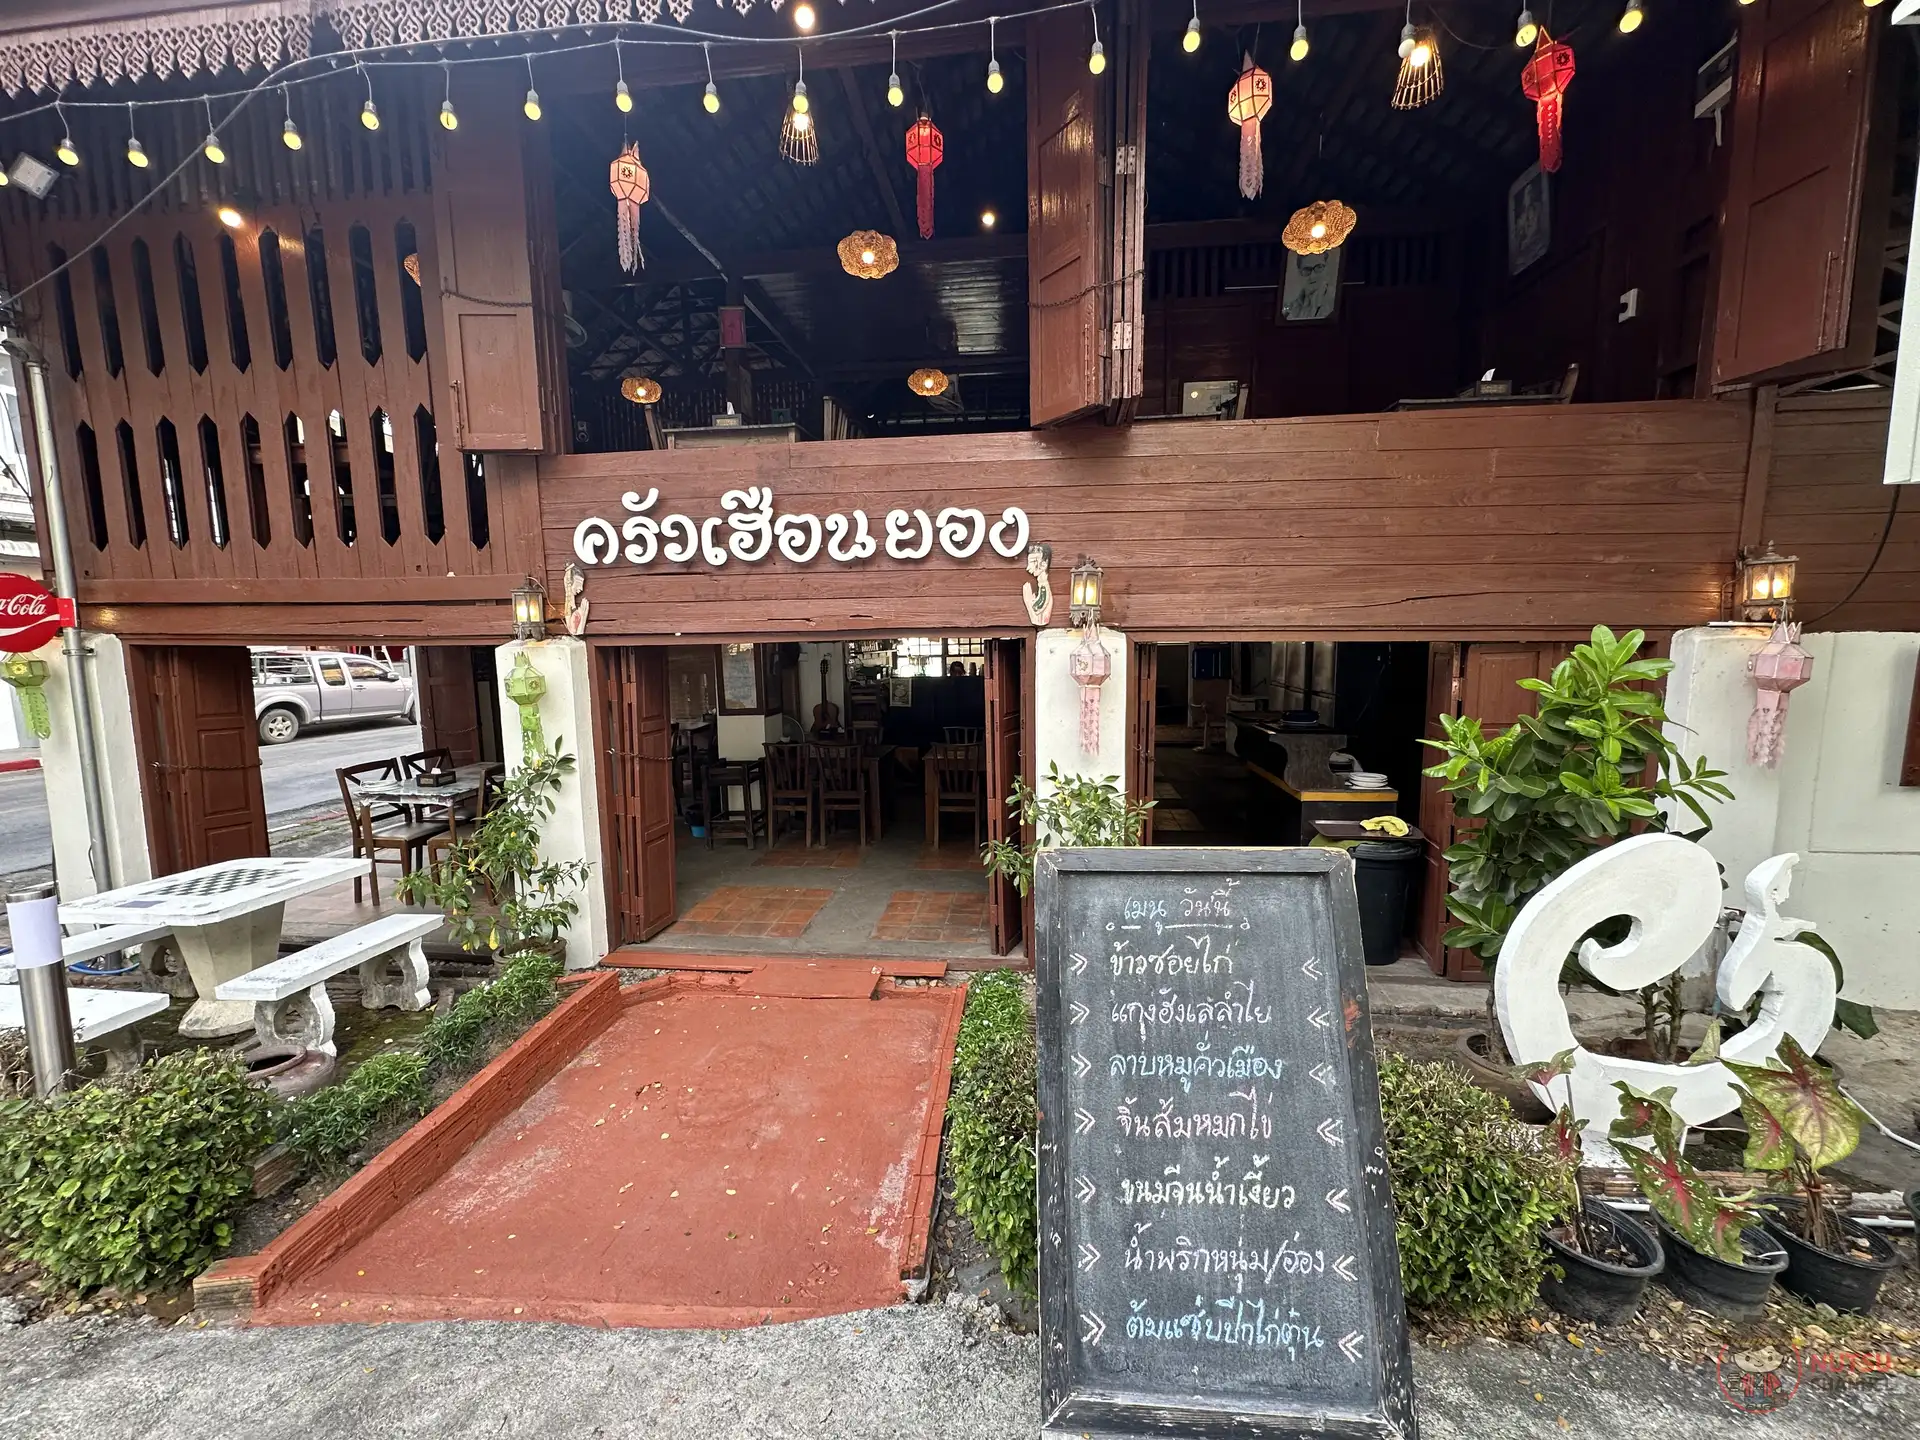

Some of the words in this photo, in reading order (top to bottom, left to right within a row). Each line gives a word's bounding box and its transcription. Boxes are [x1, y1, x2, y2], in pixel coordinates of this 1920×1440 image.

[1123, 896, 1167, 936] เมนู
[1179, 877, 1240, 918] วันนี้
[1109, 934, 1233, 976] ข้าวซอยไก่
[1108, 1030, 1283, 1093] ลาบหมูคั่วเมือง
[1120, 1154, 1296, 1209] ขนมจีนน้ำเงี้ยว
[1124, 1222, 1325, 1294] น้ำพริกหนุ่ม/อ่อง
